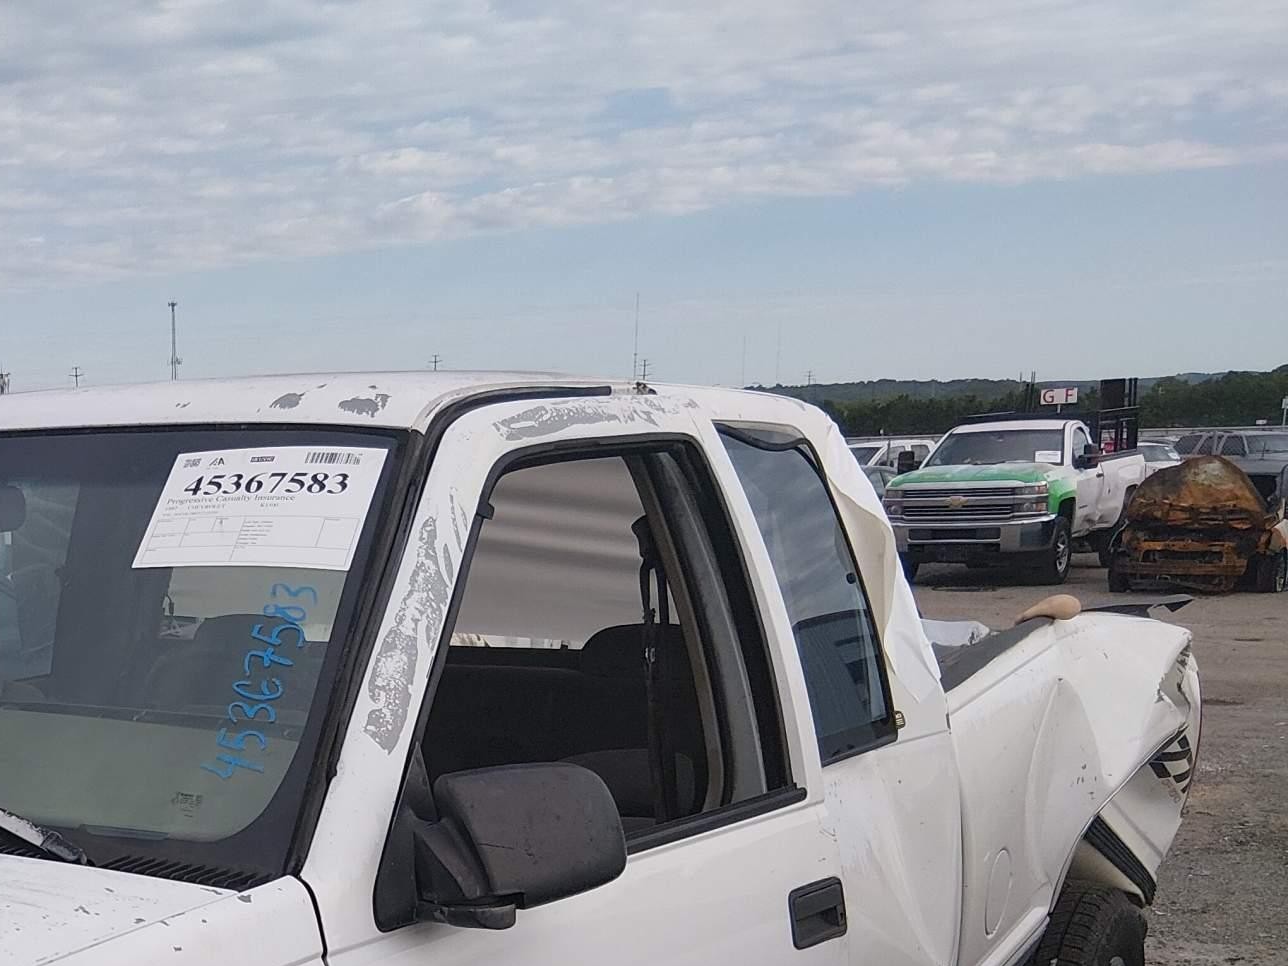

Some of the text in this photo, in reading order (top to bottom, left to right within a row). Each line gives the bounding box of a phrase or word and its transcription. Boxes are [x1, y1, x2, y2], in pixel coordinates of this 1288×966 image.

[1043, 387, 1075, 404] G F
[184, 472, 349, 496] 45367583
[167, 497, 213, 505] Progressive
[216, 495, 251, 503] Casualty
[200, 583, 318, 779] 45367583
